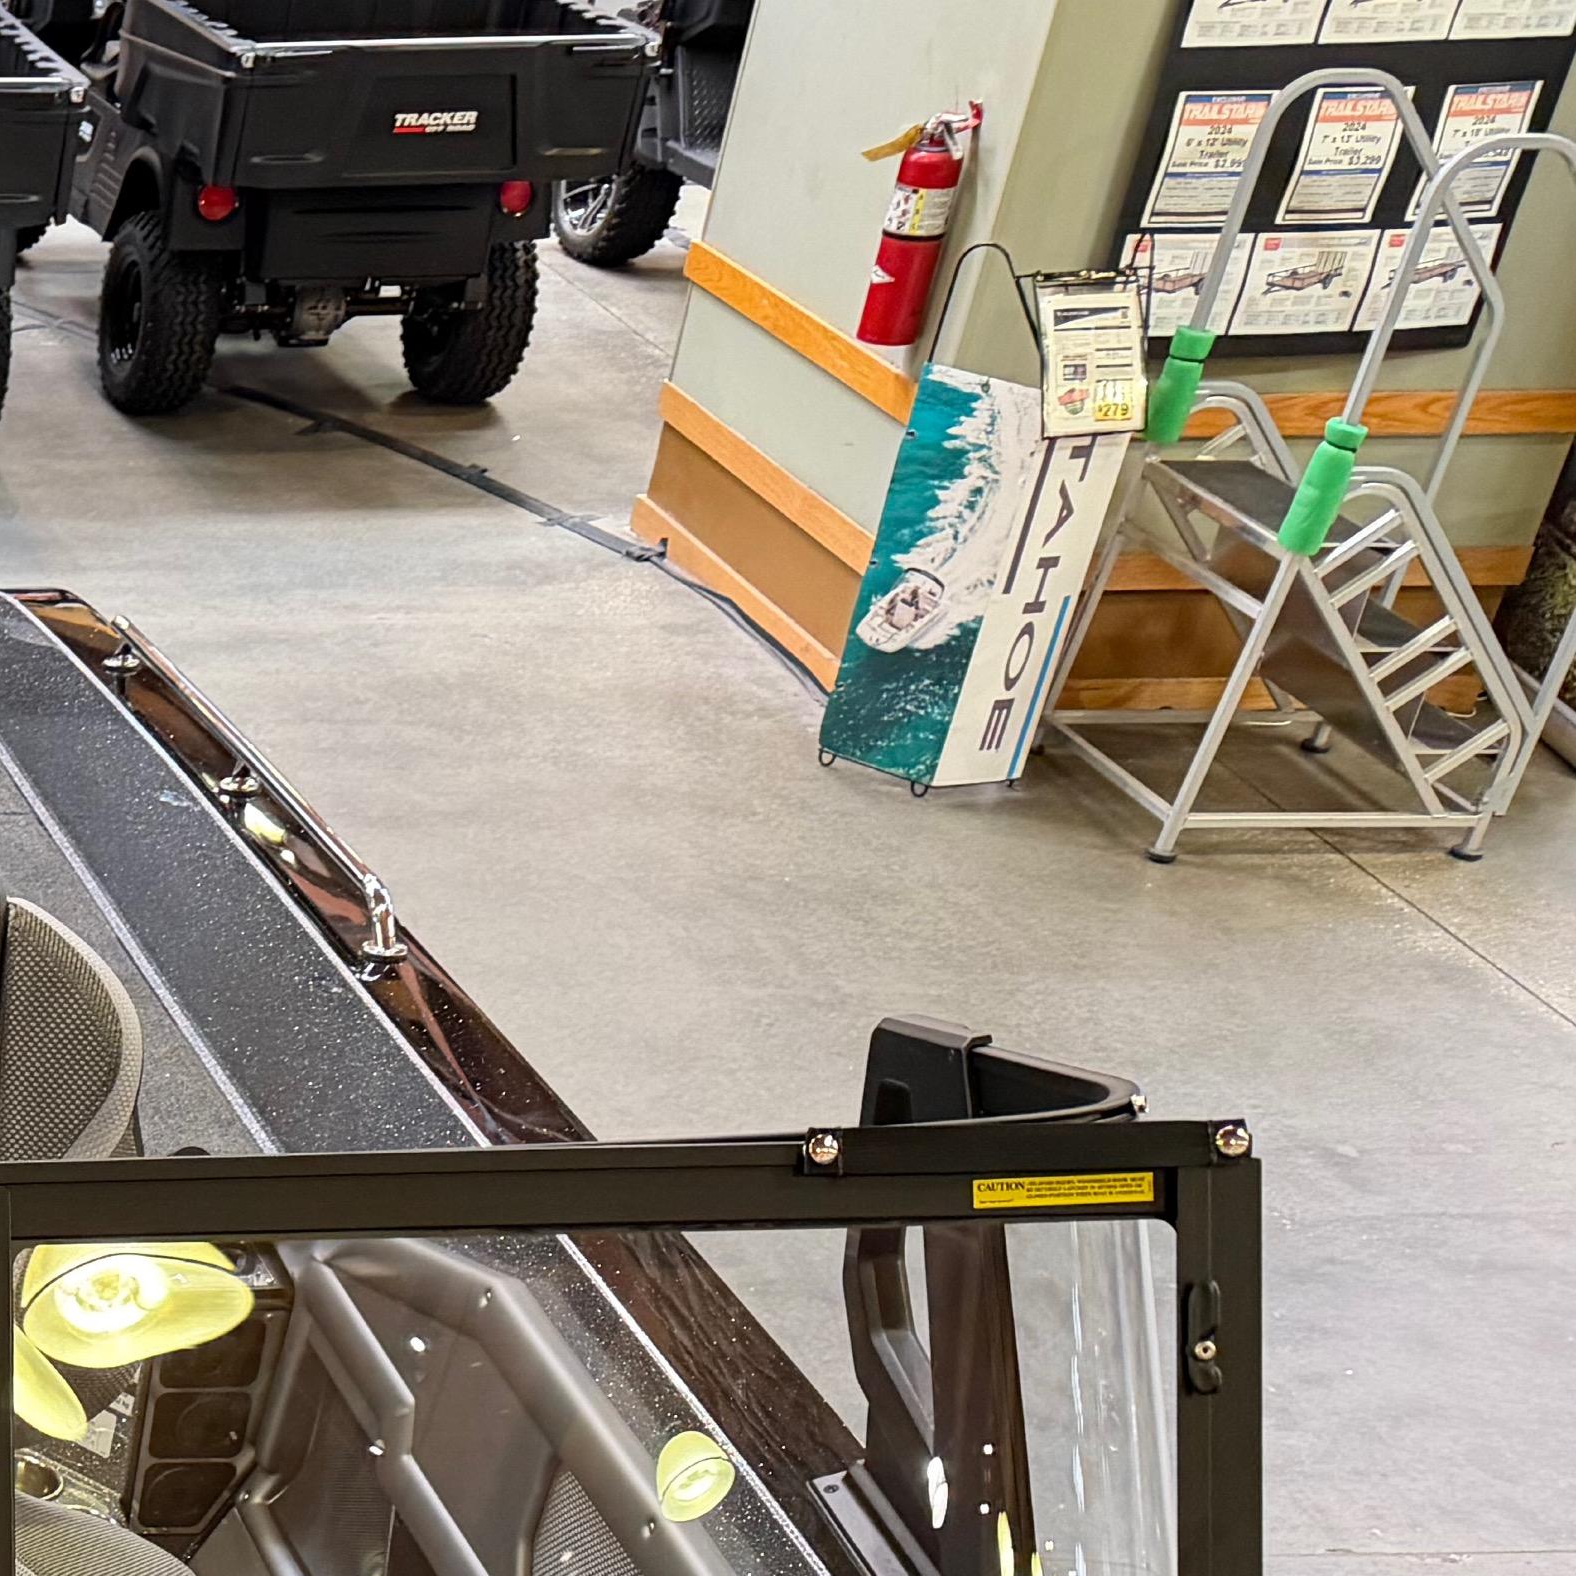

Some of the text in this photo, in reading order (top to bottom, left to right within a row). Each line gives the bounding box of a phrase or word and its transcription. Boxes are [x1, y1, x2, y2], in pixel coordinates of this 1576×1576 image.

[394, 111, 479, 126] TRACKER
[979, 435, 1098, 751] TAHOE
[977, 1182, 1025, 1192] CAUTION
